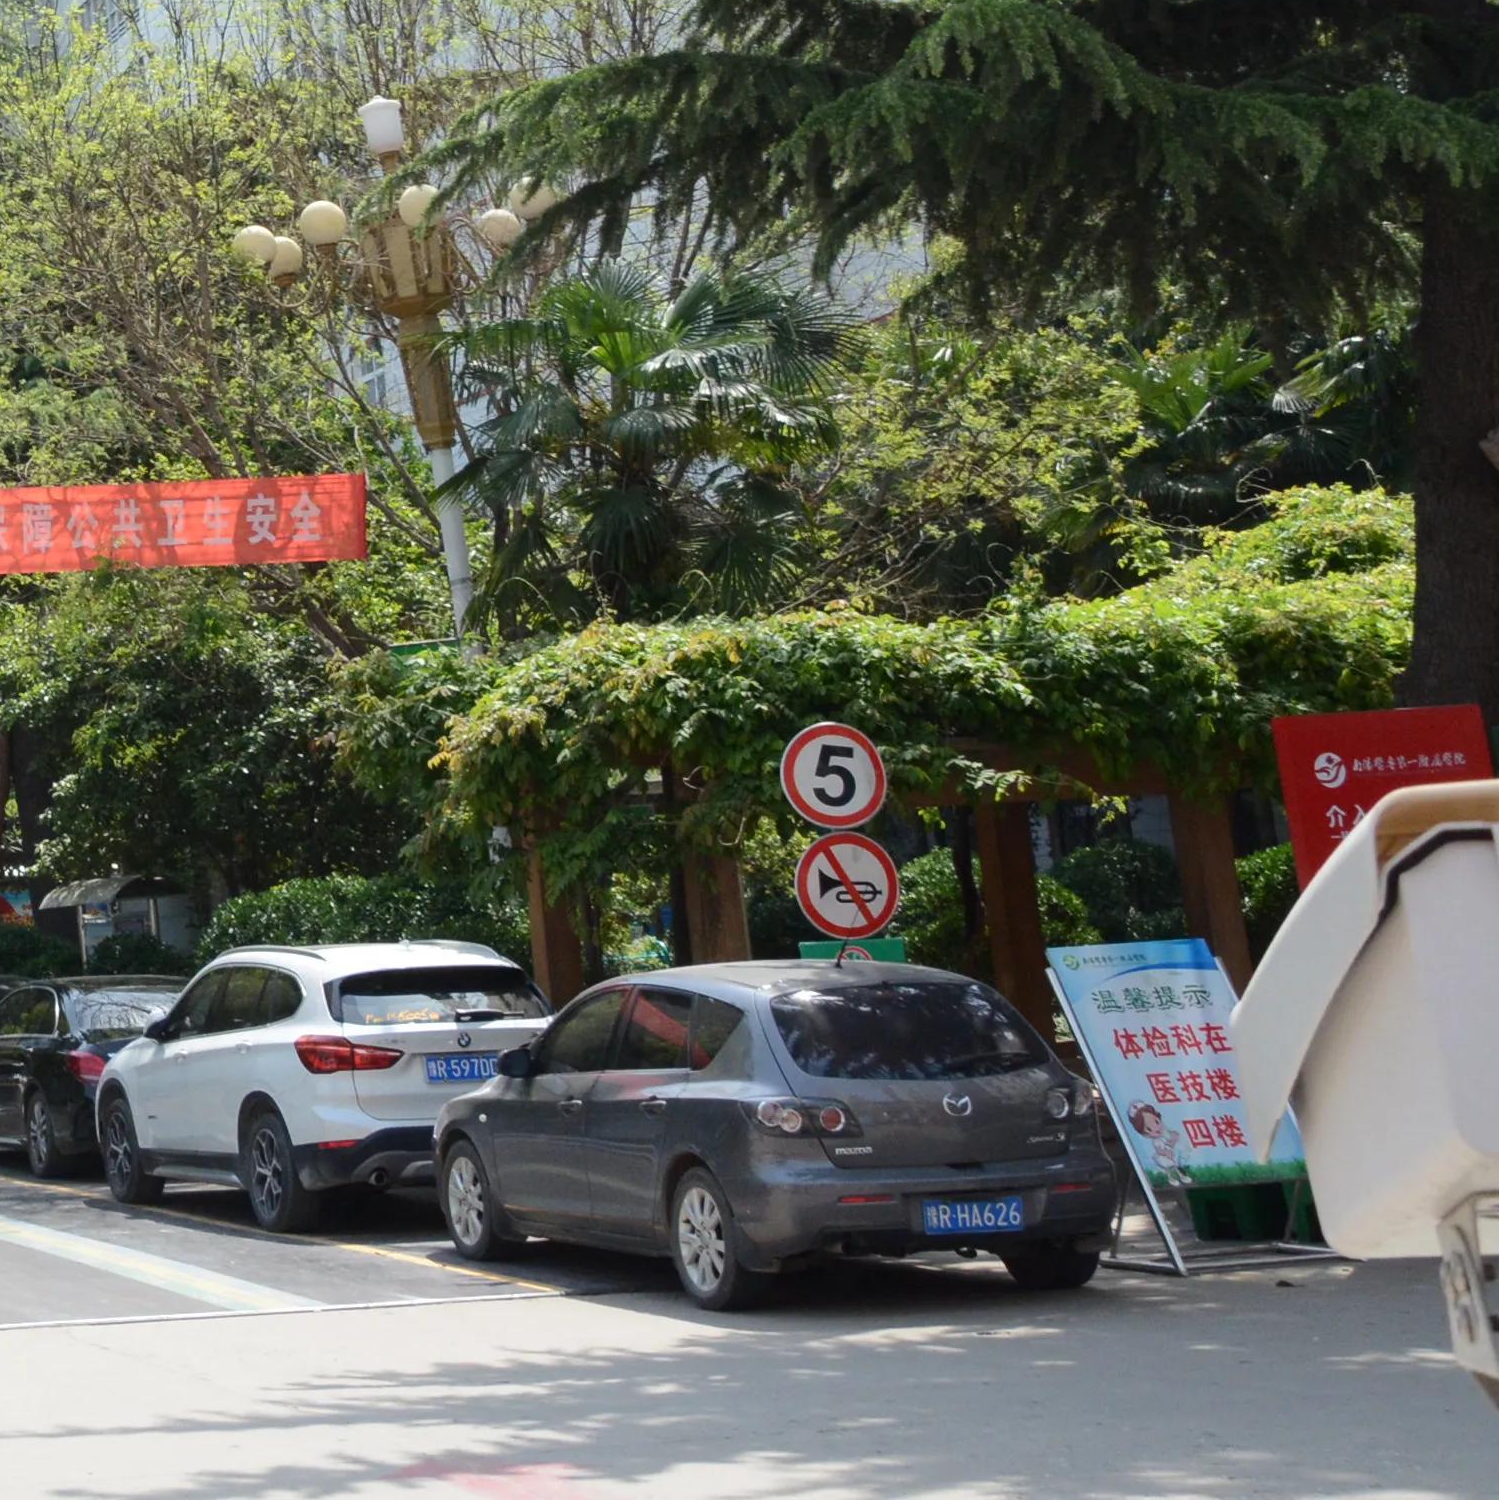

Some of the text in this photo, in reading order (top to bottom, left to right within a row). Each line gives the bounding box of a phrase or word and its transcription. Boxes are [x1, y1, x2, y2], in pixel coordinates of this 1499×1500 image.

[813, 745, 856, 807] 5
[1091, 984, 1213, 1013] 温馨提示
[1113, 1022, 1234, 1060] 体检科在
[1146, 1068, 1241, 1104] 医技楼
[1182, 1114, 1248, 1149] 四楼
